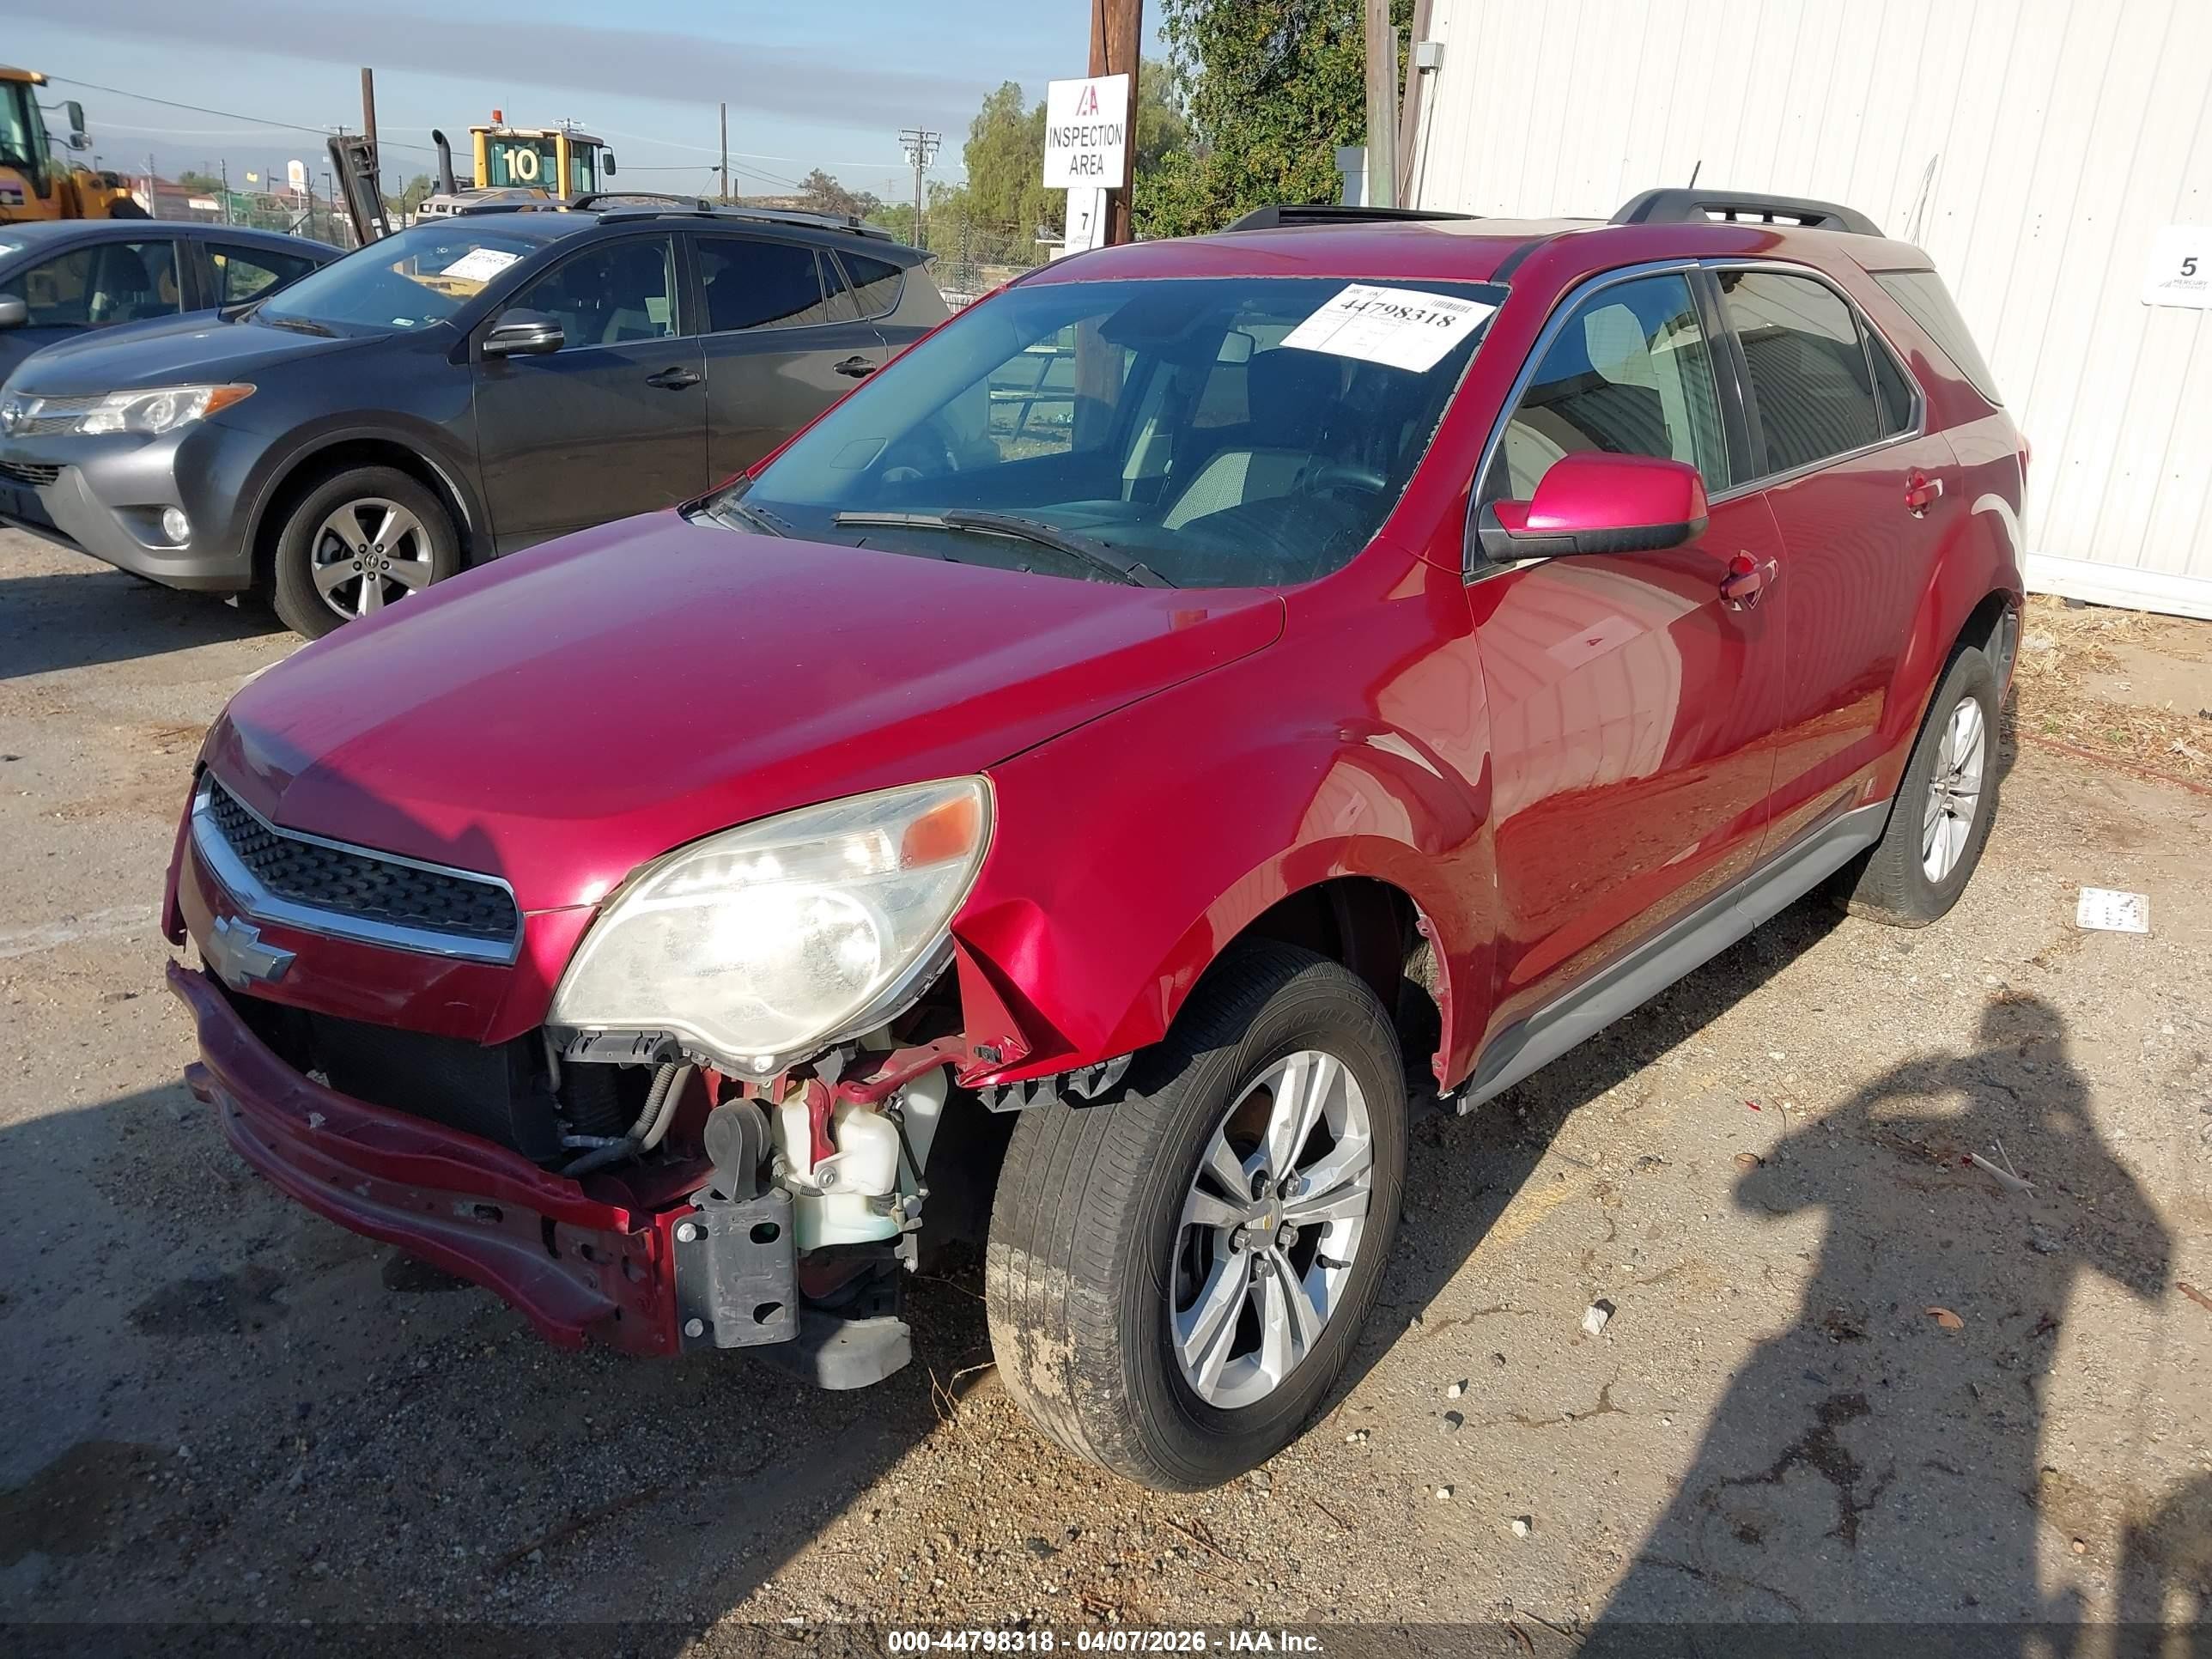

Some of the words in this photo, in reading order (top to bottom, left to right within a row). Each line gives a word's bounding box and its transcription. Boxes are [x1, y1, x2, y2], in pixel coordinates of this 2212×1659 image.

[1048, 123, 1122, 148] INSPECTION
[502, 149, 538, 180] 10
[1069, 154, 1104, 175] AREA
[1081, 212, 1089, 230] 7
[2180, 257, 2198, 276] 5
[1340, 299, 1456, 328] 44798318
